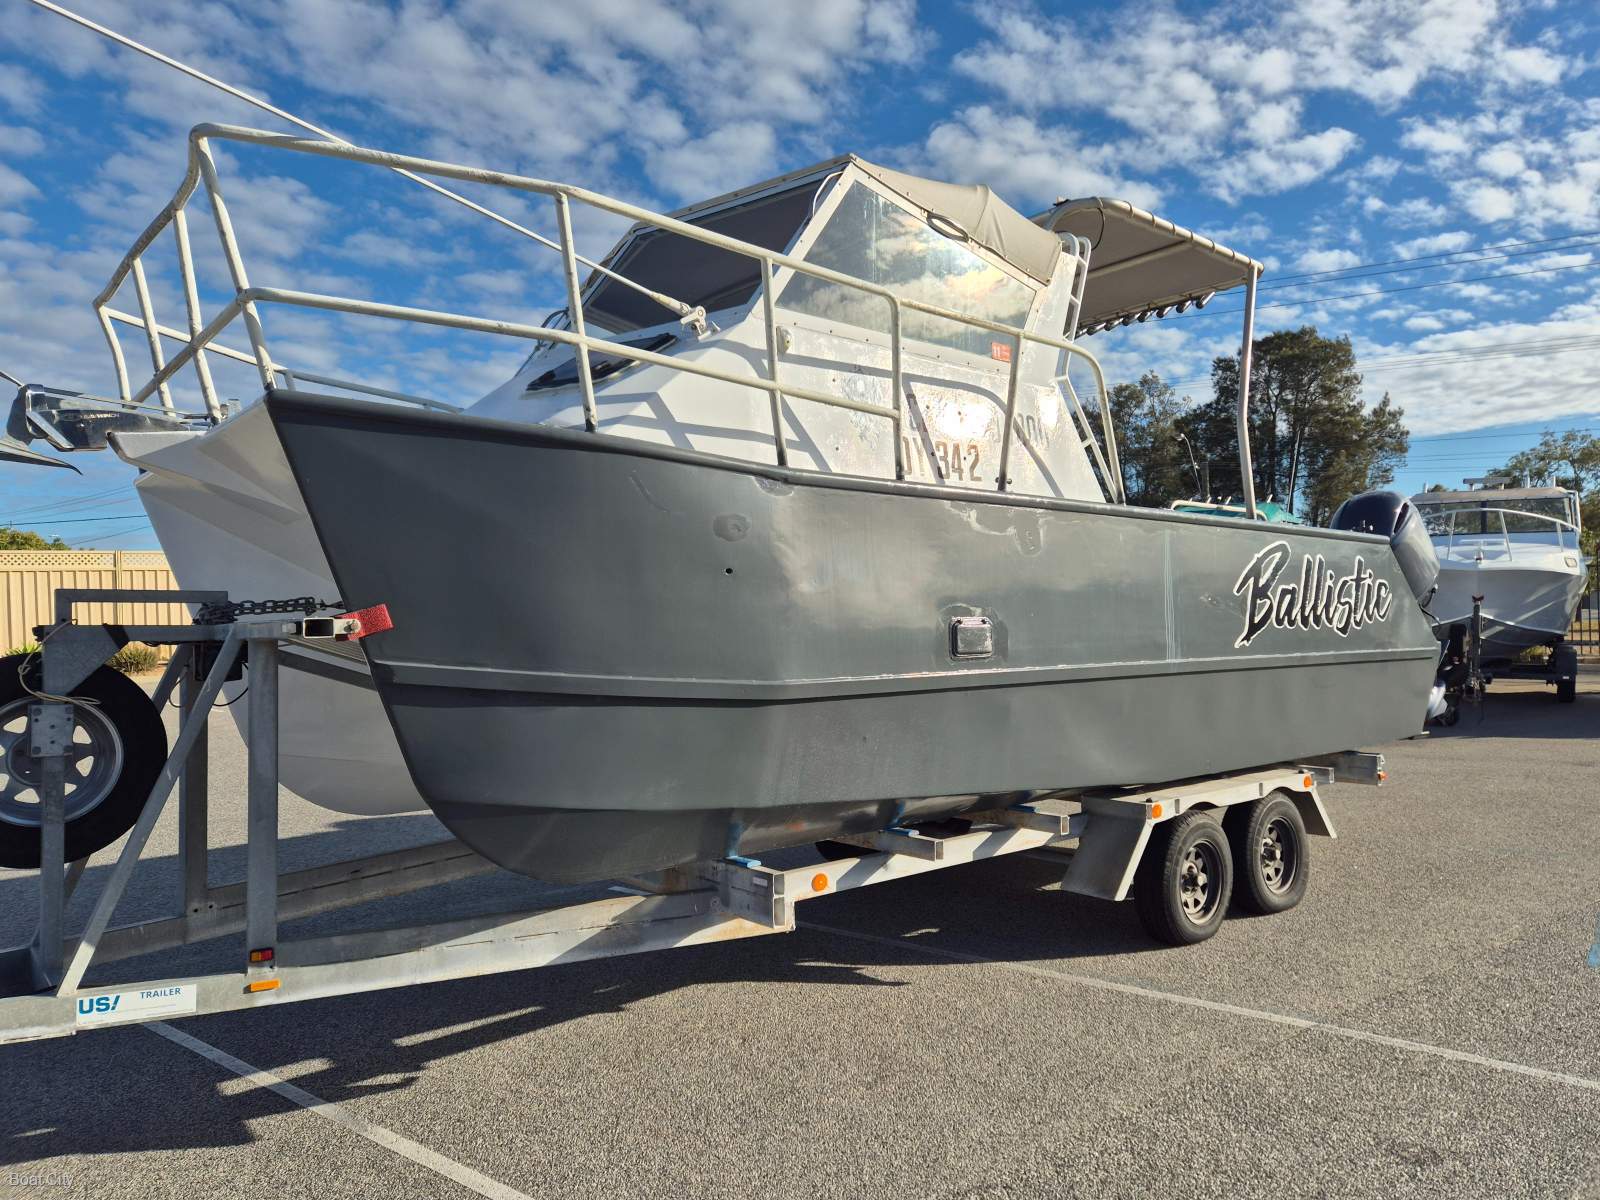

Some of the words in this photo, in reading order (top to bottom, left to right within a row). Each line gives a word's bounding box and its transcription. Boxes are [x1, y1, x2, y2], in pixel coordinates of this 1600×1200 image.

[935, 440, 982, 481] 342
[1233, 540, 1392, 648] Ballistic
[140, 987, 181, 999] TRAILER
